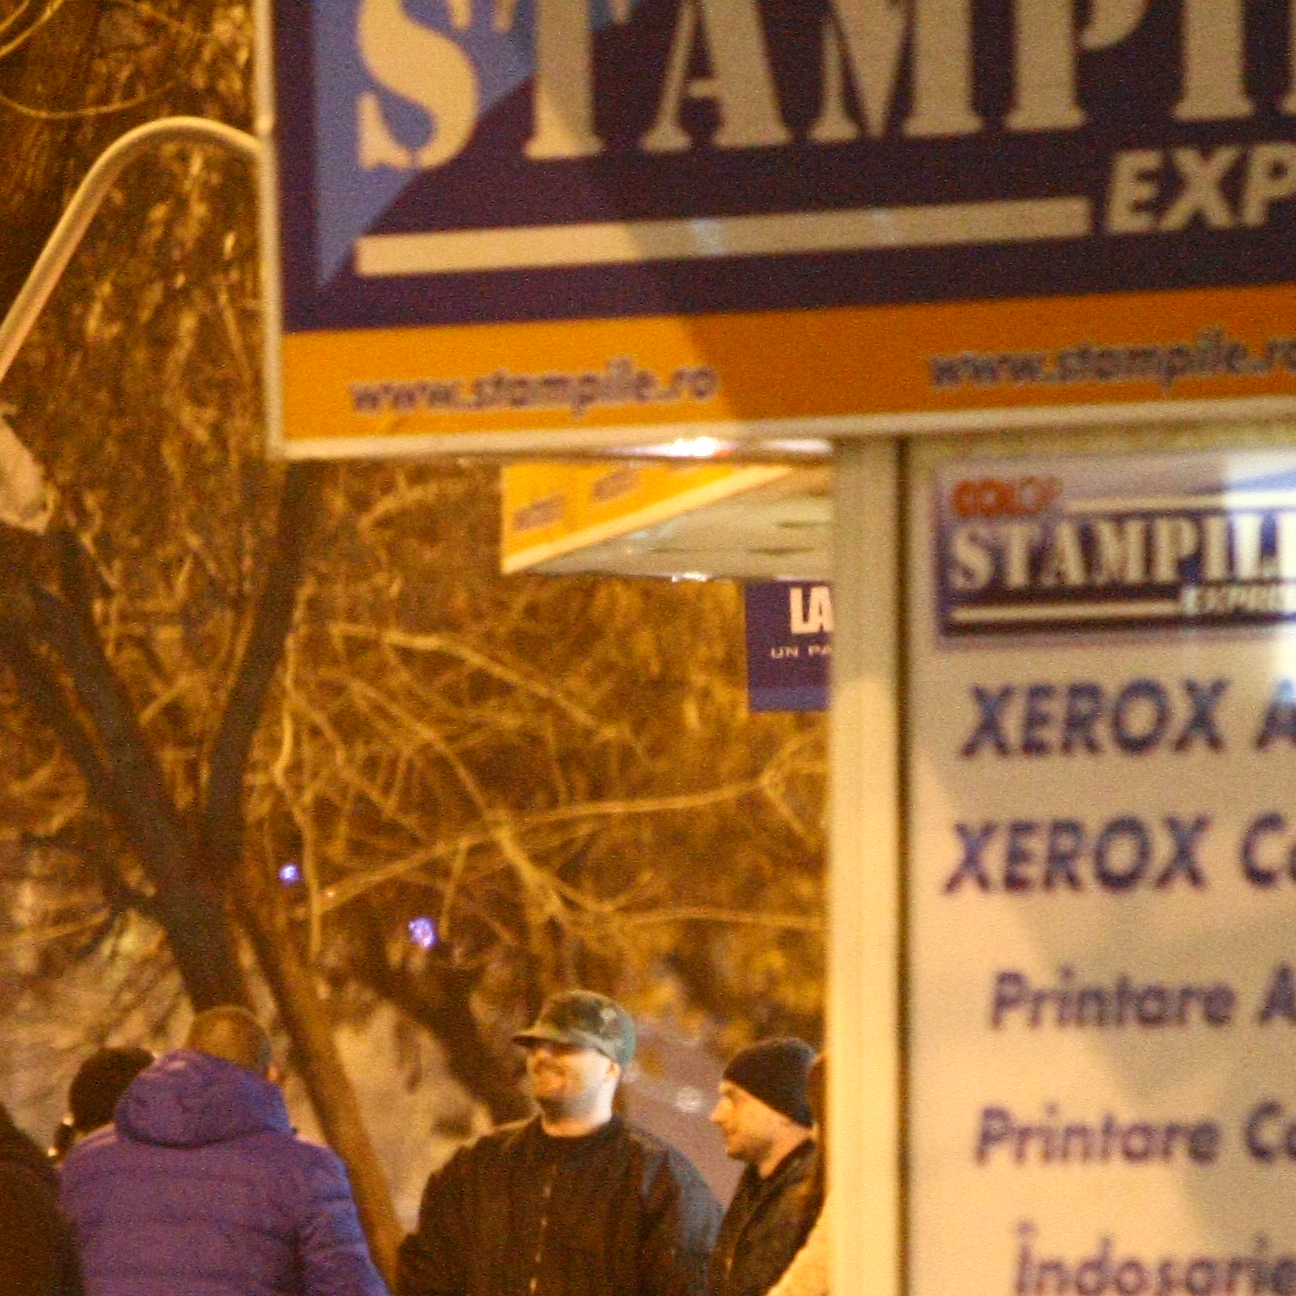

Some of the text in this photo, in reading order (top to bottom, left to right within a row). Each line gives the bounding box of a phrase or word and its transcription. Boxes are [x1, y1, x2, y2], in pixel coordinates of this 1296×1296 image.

[349, 357, 718, 414] www.stampile.ro
[961, 675, 1232, 758] XEROX
[944, 814, 1210, 895] XEROX
[990, 965, 1237, 1030] Printare
[974, 1103, 1222, 1168] Printare
